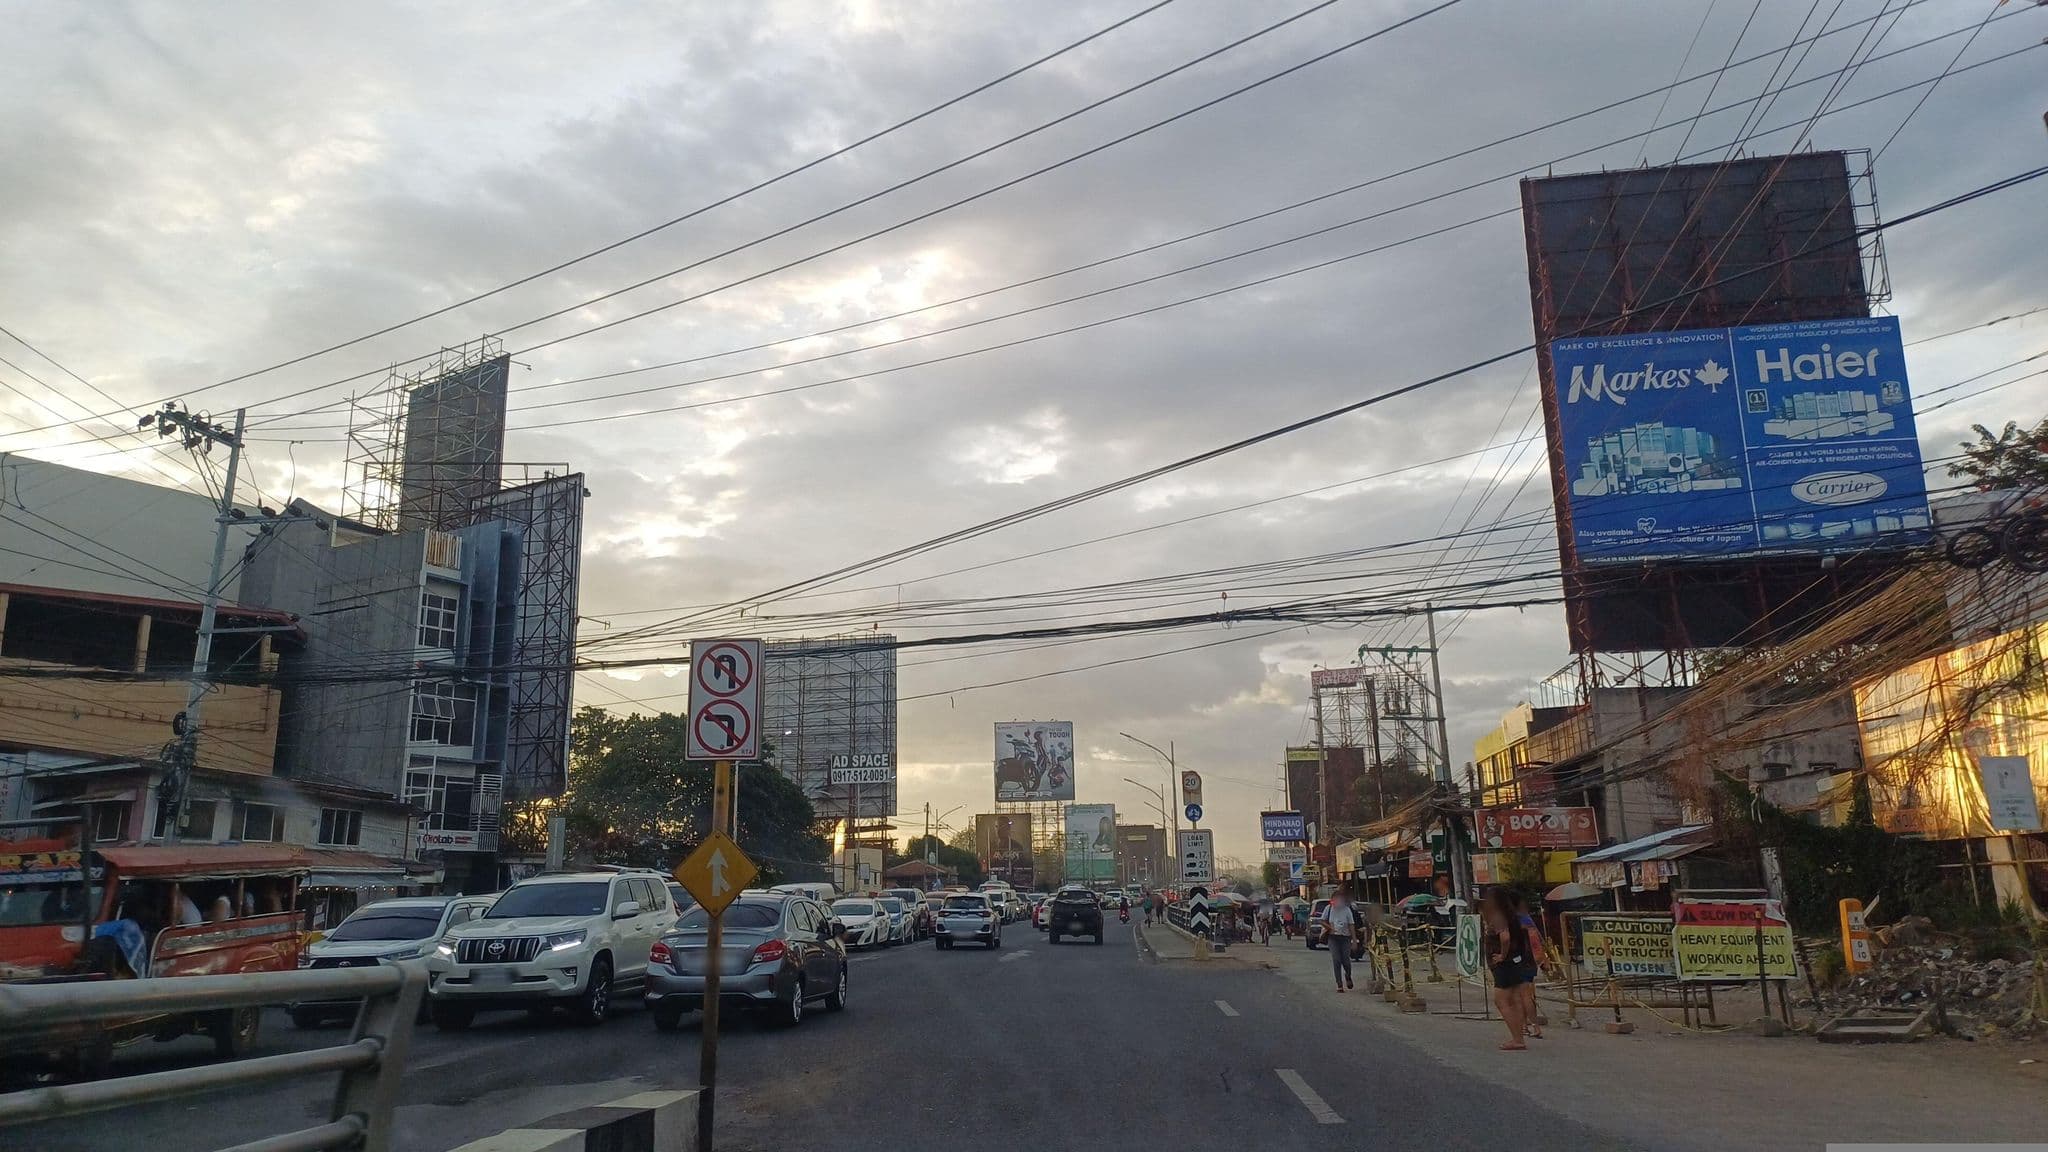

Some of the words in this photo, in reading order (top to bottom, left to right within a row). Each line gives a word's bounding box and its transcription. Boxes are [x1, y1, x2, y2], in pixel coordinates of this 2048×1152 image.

[1559, 342, 1584, 351] MARK
[1587, 341, 1599, 350] OF
[1602, 338, 1653, 348] EXCELLENCE
[1667, 334, 1724, 344] INNOVATION
[1756, 343, 1879, 383] Haier
[1568, 362, 1691, 405] Markes
[1806, 480, 1875, 496] Carrier
[832, 755, 850, 768] AD
[852, 754, 889, 767] SPACE
[832, 769, 889, 783] 0917-512-0091
[1185, 778, 1196, 786] 20
[1264, 820, 1301, 828] MINDANAO
[1266, 829, 1300, 837] DAILY
[1701, 910, 1735, 920] SLOW
[1605, 921, 1664, 933] CAUTION
[1627, 937, 1669, 948] GOING
[1680, 934, 1717, 945] HEAVY
[1720, 934, 1785, 946] EQUIPENT
[1687, 953, 1743, 965] WORKING
[1614, 962, 1665, 974] BOYSEN
